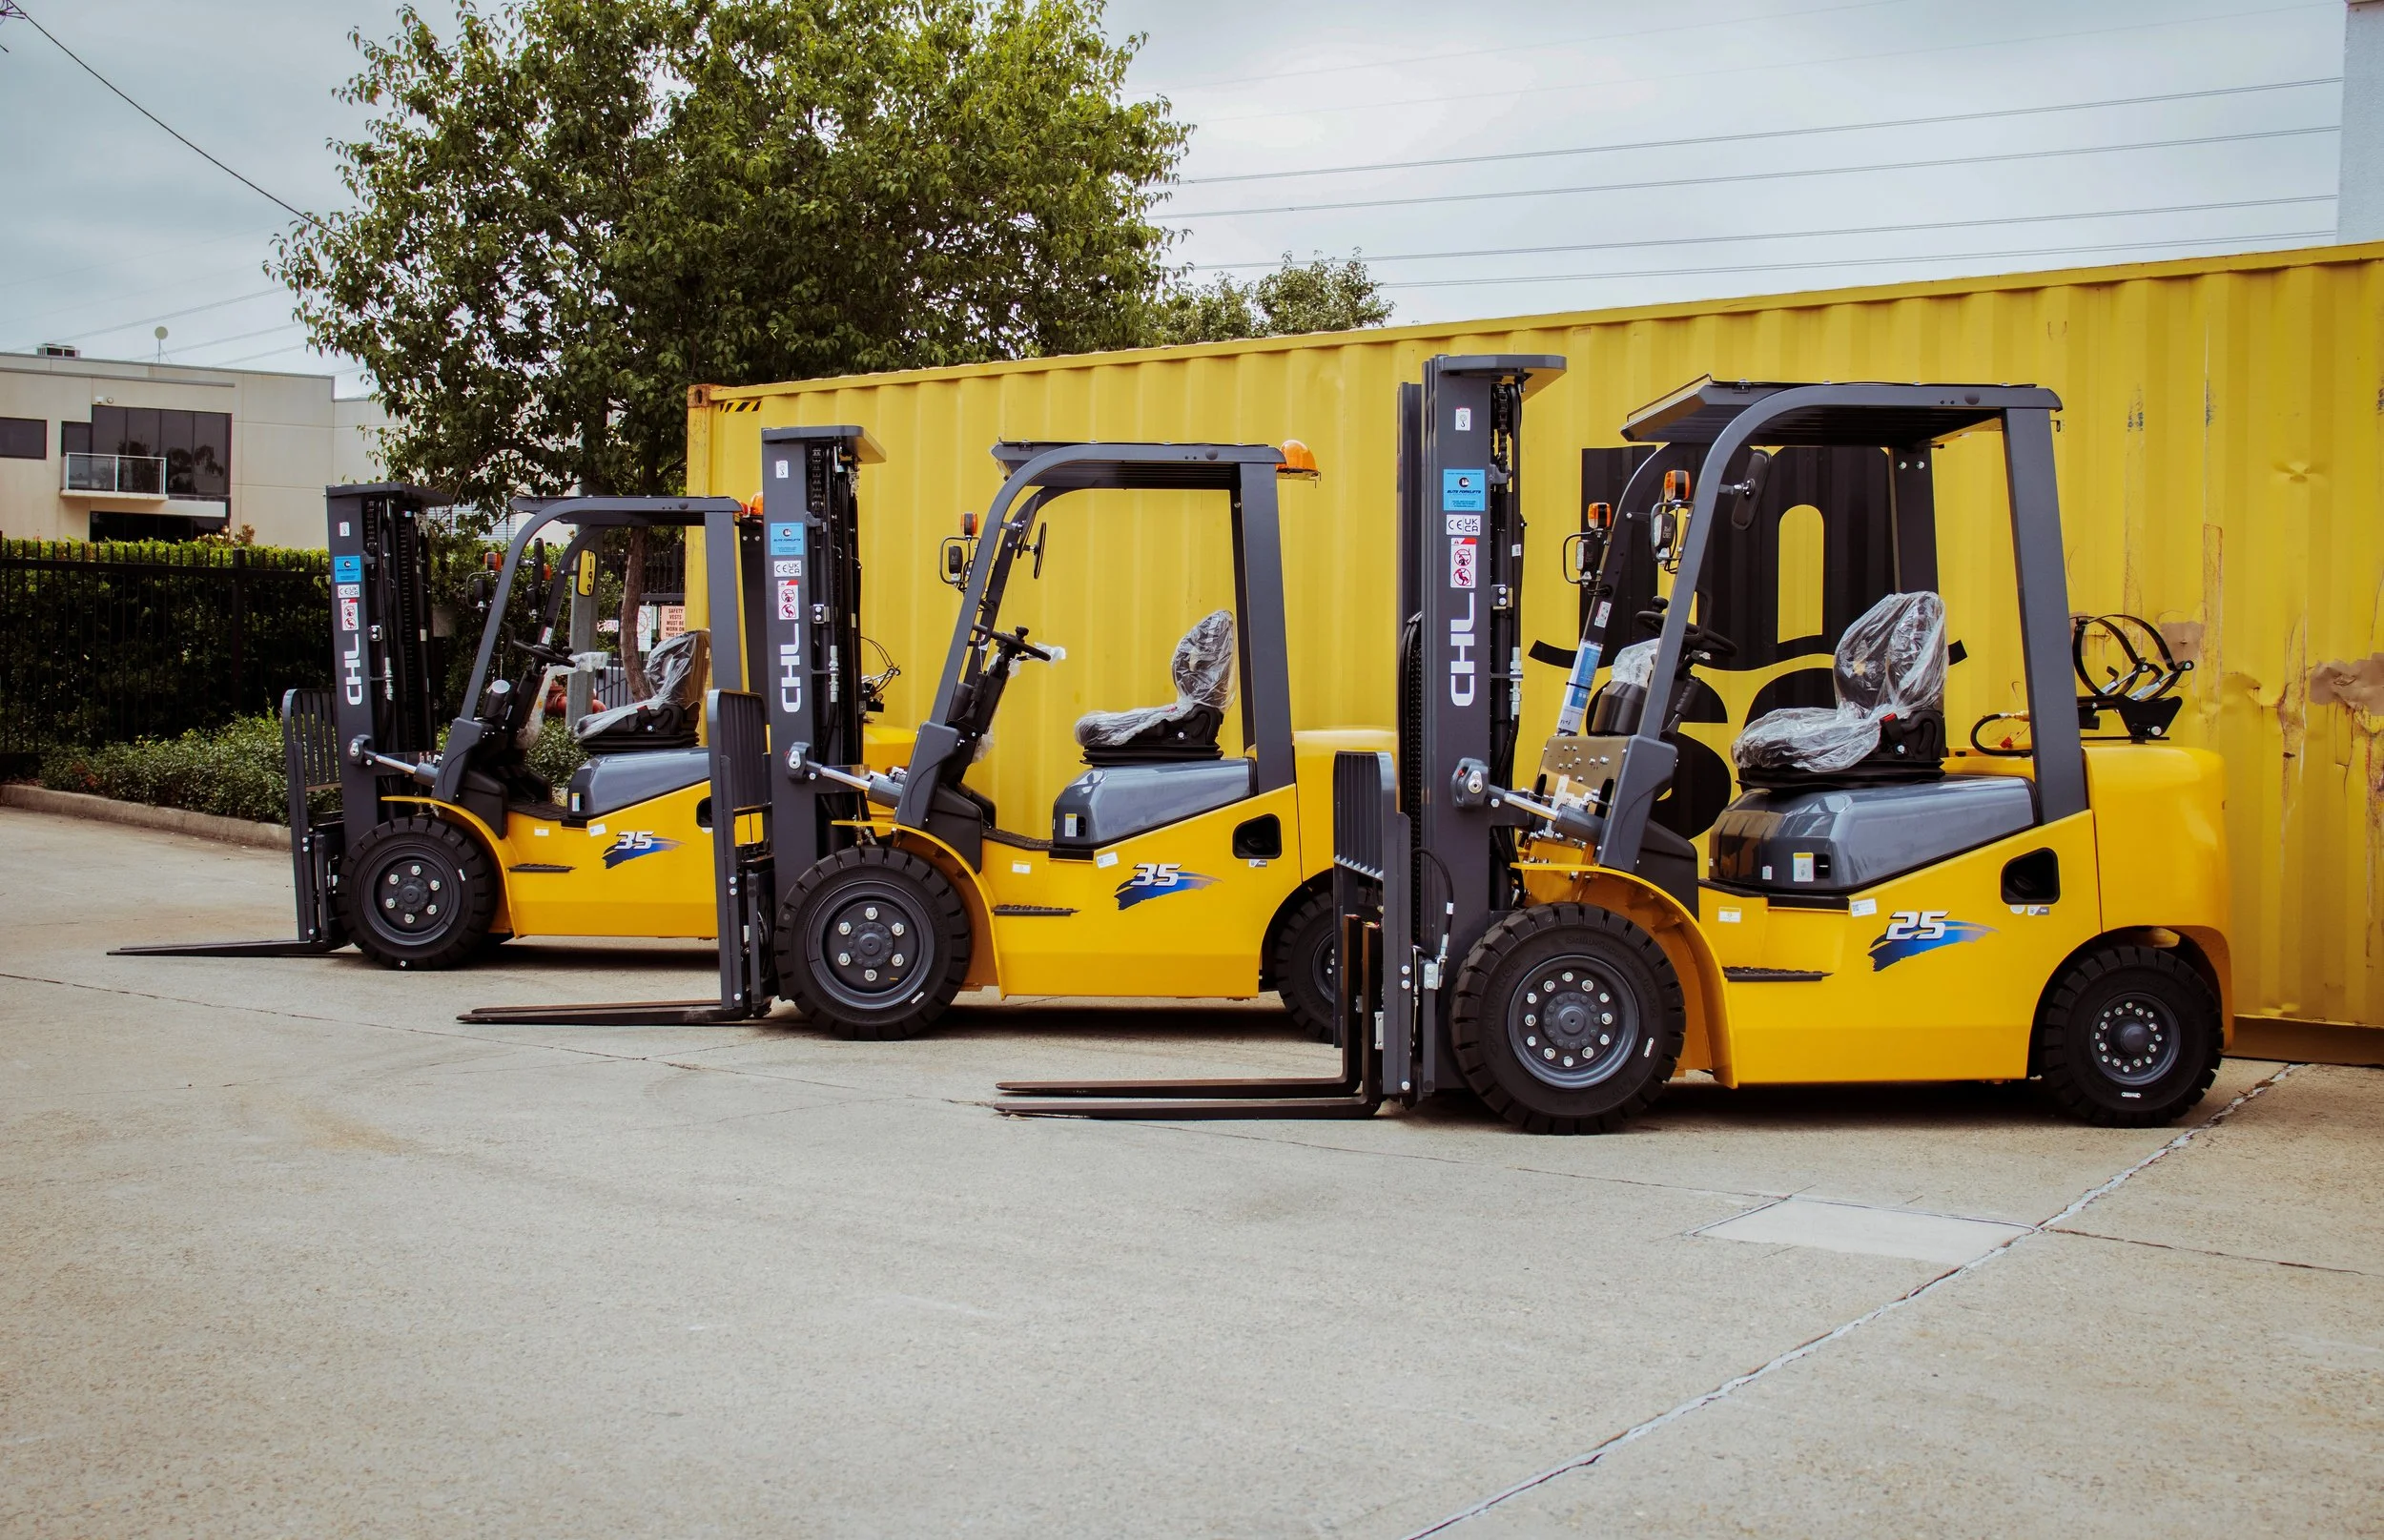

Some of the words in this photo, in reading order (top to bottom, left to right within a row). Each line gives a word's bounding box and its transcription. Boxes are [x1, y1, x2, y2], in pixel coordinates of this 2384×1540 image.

[1449, 519, 1462, 530] CE
[775, 564, 788, 573] CE
[1449, 592, 1475, 707] CHL
[344, 633, 362, 706] CHL
[780, 623, 801, 713] CHL
[614, 831, 654, 850] 35
[1129, 863, 1182, 887] 35
[1885, 911, 1950, 940] 25
